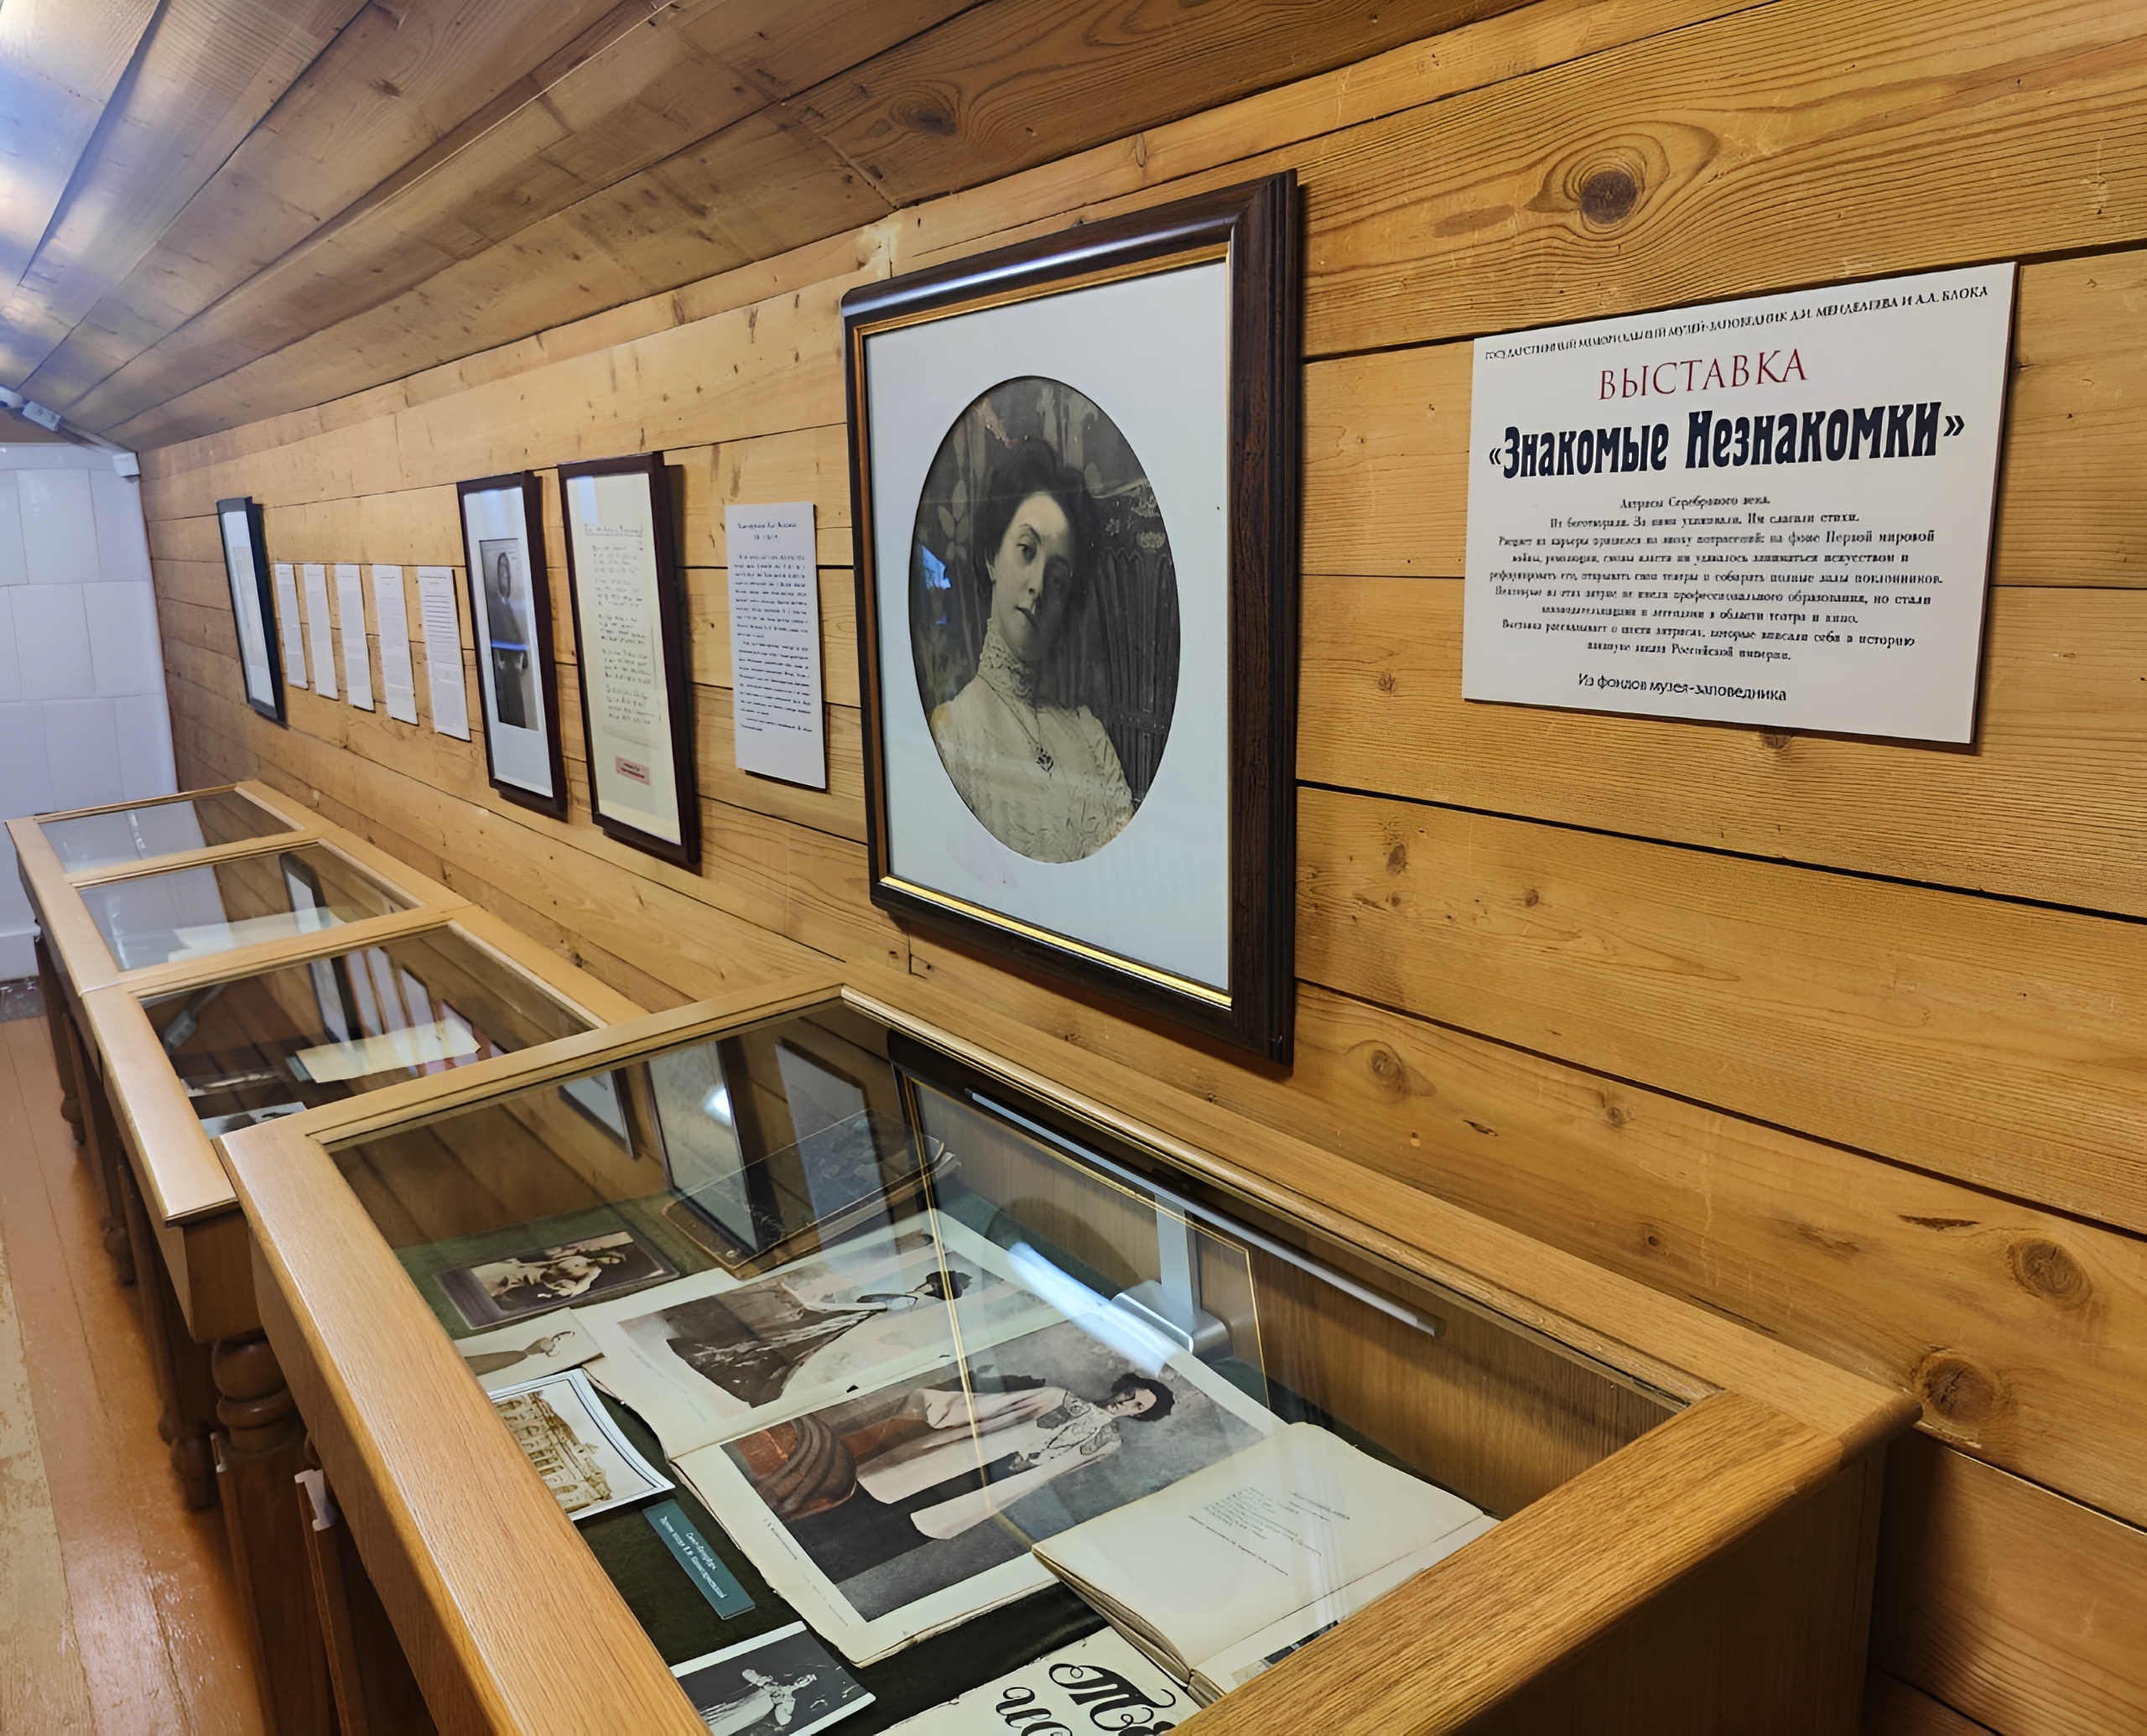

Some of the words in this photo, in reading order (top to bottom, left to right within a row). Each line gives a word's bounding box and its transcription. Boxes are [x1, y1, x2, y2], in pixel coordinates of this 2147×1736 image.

[1902, 296, 1912, 306] И
[1942, 286, 1988, 301] БЛОКА
[1599, 349, 1807, 400] ВЫСТАВКА
[1489, 424, 1669, 479] «Знакомые
[1685, 402, 1964, 469] Незнакомки»
[1770, 515, 1814, 523] слагали
[1821, 514, 1859, 522] стихи.
[1827, 531, 1872, 546] Первой
[1879, 530, 1934, 545] мировой
[1824, 554, 1894, 565] искусством
[1855, 574, 1942, 584] поклонников.
[1874, 595, 1889, 604] но
[1895, 596, 1931, 605] стали
[1720, 608, 1764, 620] области
[1859, 636, 1915, 648] историю
[1579, 673, 1593, 686] Из
